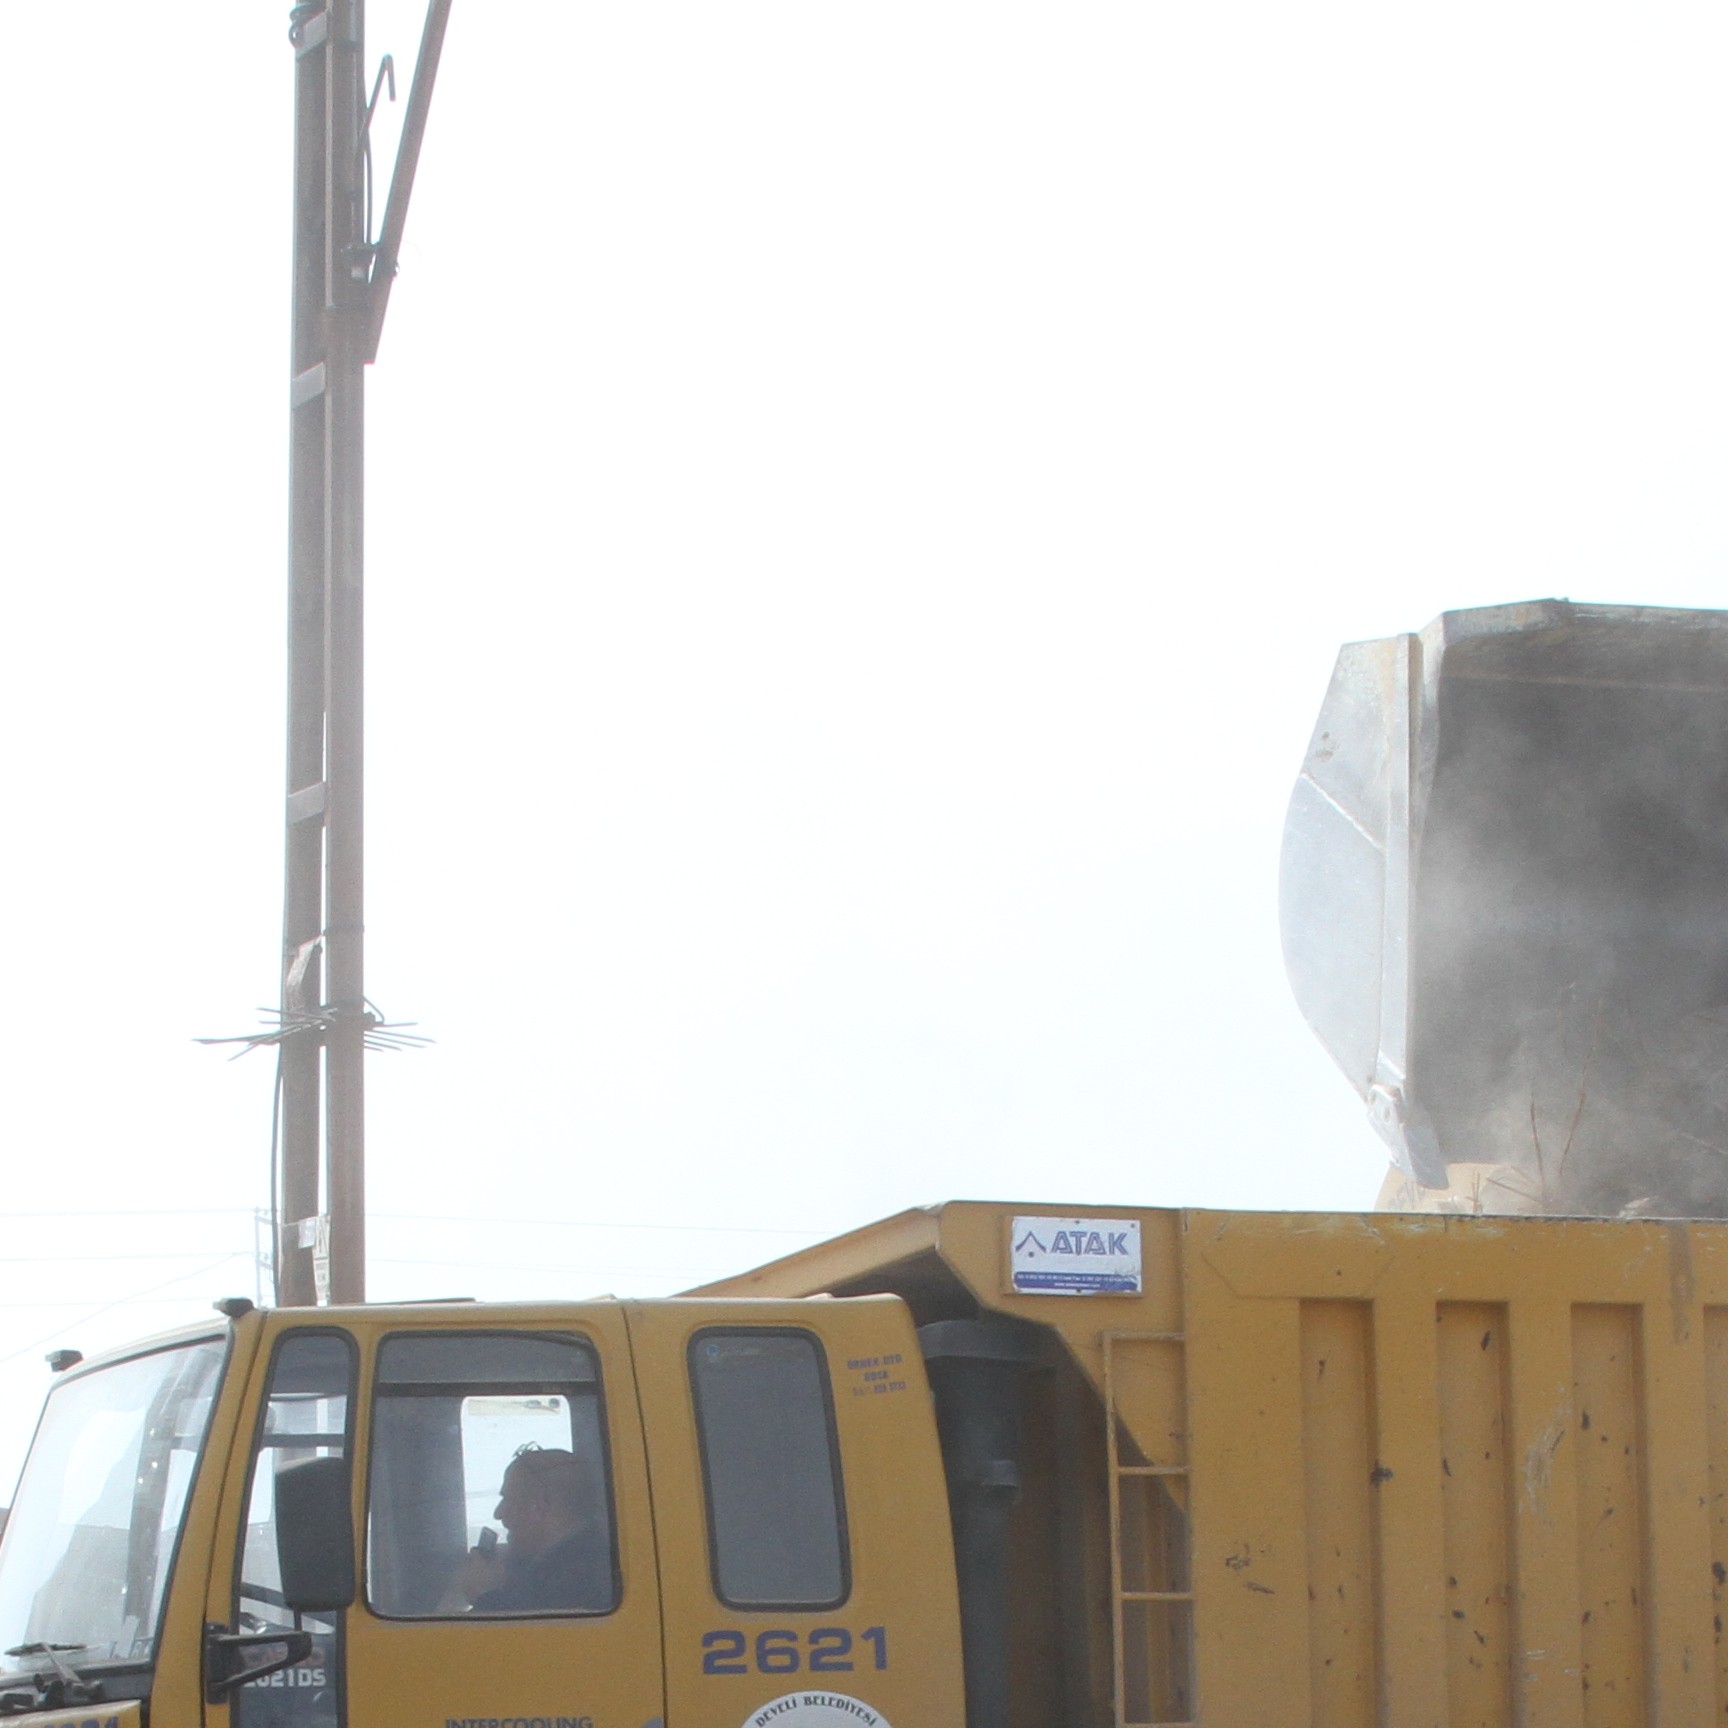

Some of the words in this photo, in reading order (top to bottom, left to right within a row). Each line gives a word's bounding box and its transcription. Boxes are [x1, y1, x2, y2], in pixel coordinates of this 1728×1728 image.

[1049, 1230, 1130, 1256] ATAK
[701, 1626, 888, 1675] 2621
[243, 1668, 327, 1688] 21DS
[755, 1695, 798, 1728] DEVELİ
[803, 1696, 878, 1727] BELEDİYESİ
